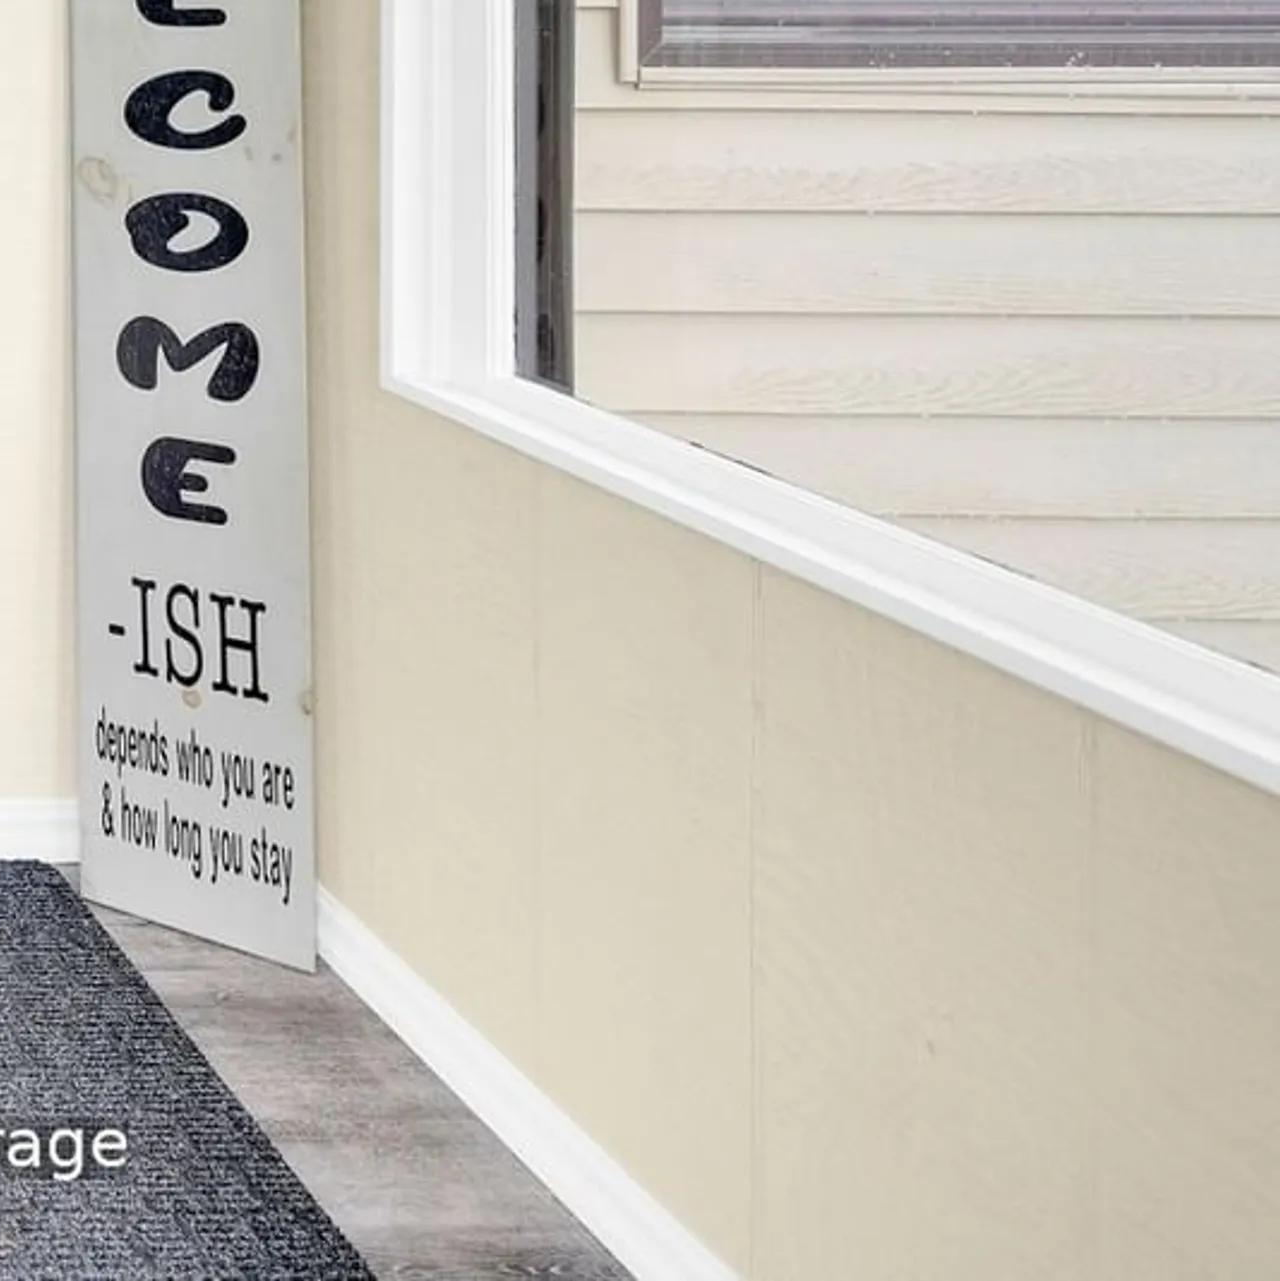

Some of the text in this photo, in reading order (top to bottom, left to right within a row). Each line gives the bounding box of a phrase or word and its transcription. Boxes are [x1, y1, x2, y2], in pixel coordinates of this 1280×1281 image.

[108, 577, 269, 702] -ISH
[96, 705, 295, 810] depends who you are
[101, 781, 293, 906] & how long you stay
